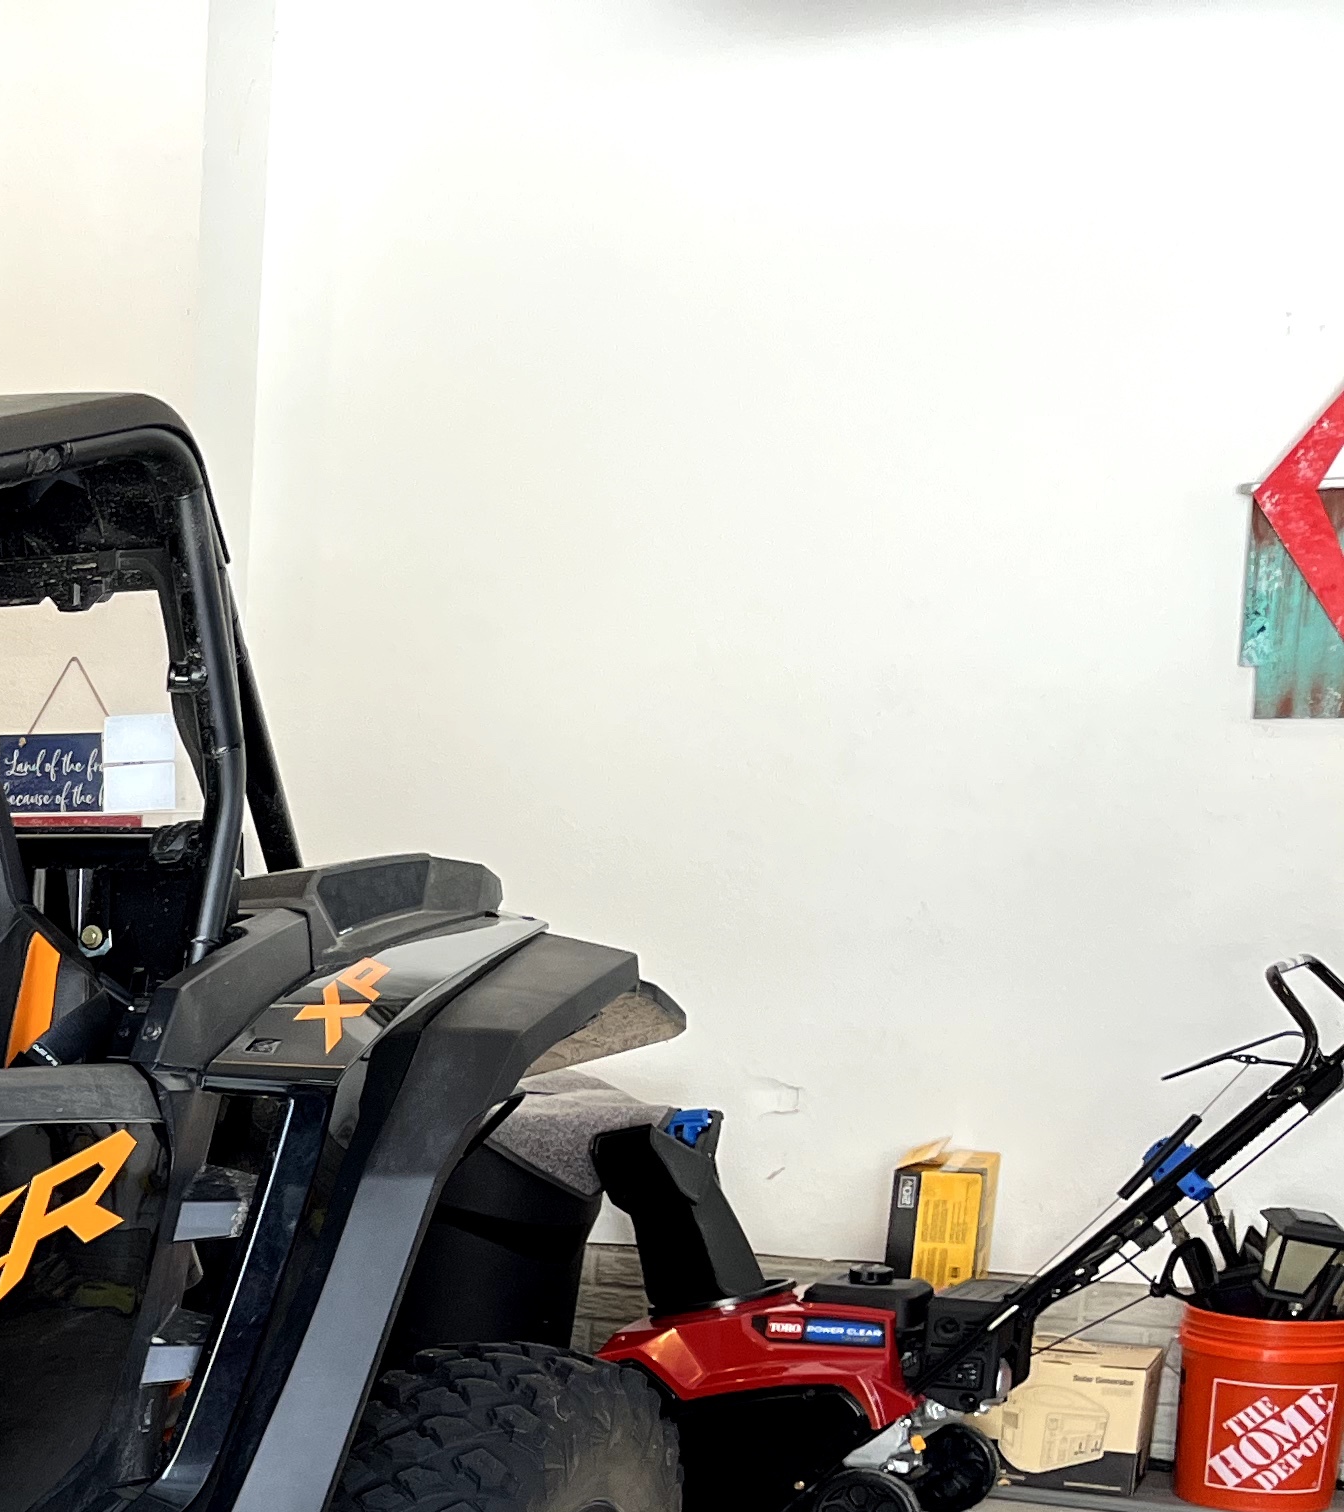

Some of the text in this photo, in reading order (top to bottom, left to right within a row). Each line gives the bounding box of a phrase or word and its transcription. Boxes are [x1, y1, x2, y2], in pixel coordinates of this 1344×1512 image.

[3, 749, 46, 777] Land
[45, 748, 61, 782] of
[62, 750, 86, 776] the
[54, 781, 71, 812] of
[72, 783, 95, 807] the
[293, 956, 392, 1055] XP
[769, 1322, 802, 1334] TORO
[807, 1324, 883, 1338] POWER CLEAR
[1222, 1395, 1281, 1438] THE
[1208, 1387, 1333, 1488] HOME
[1253, 1426, 1329, 1491] DEPOT
